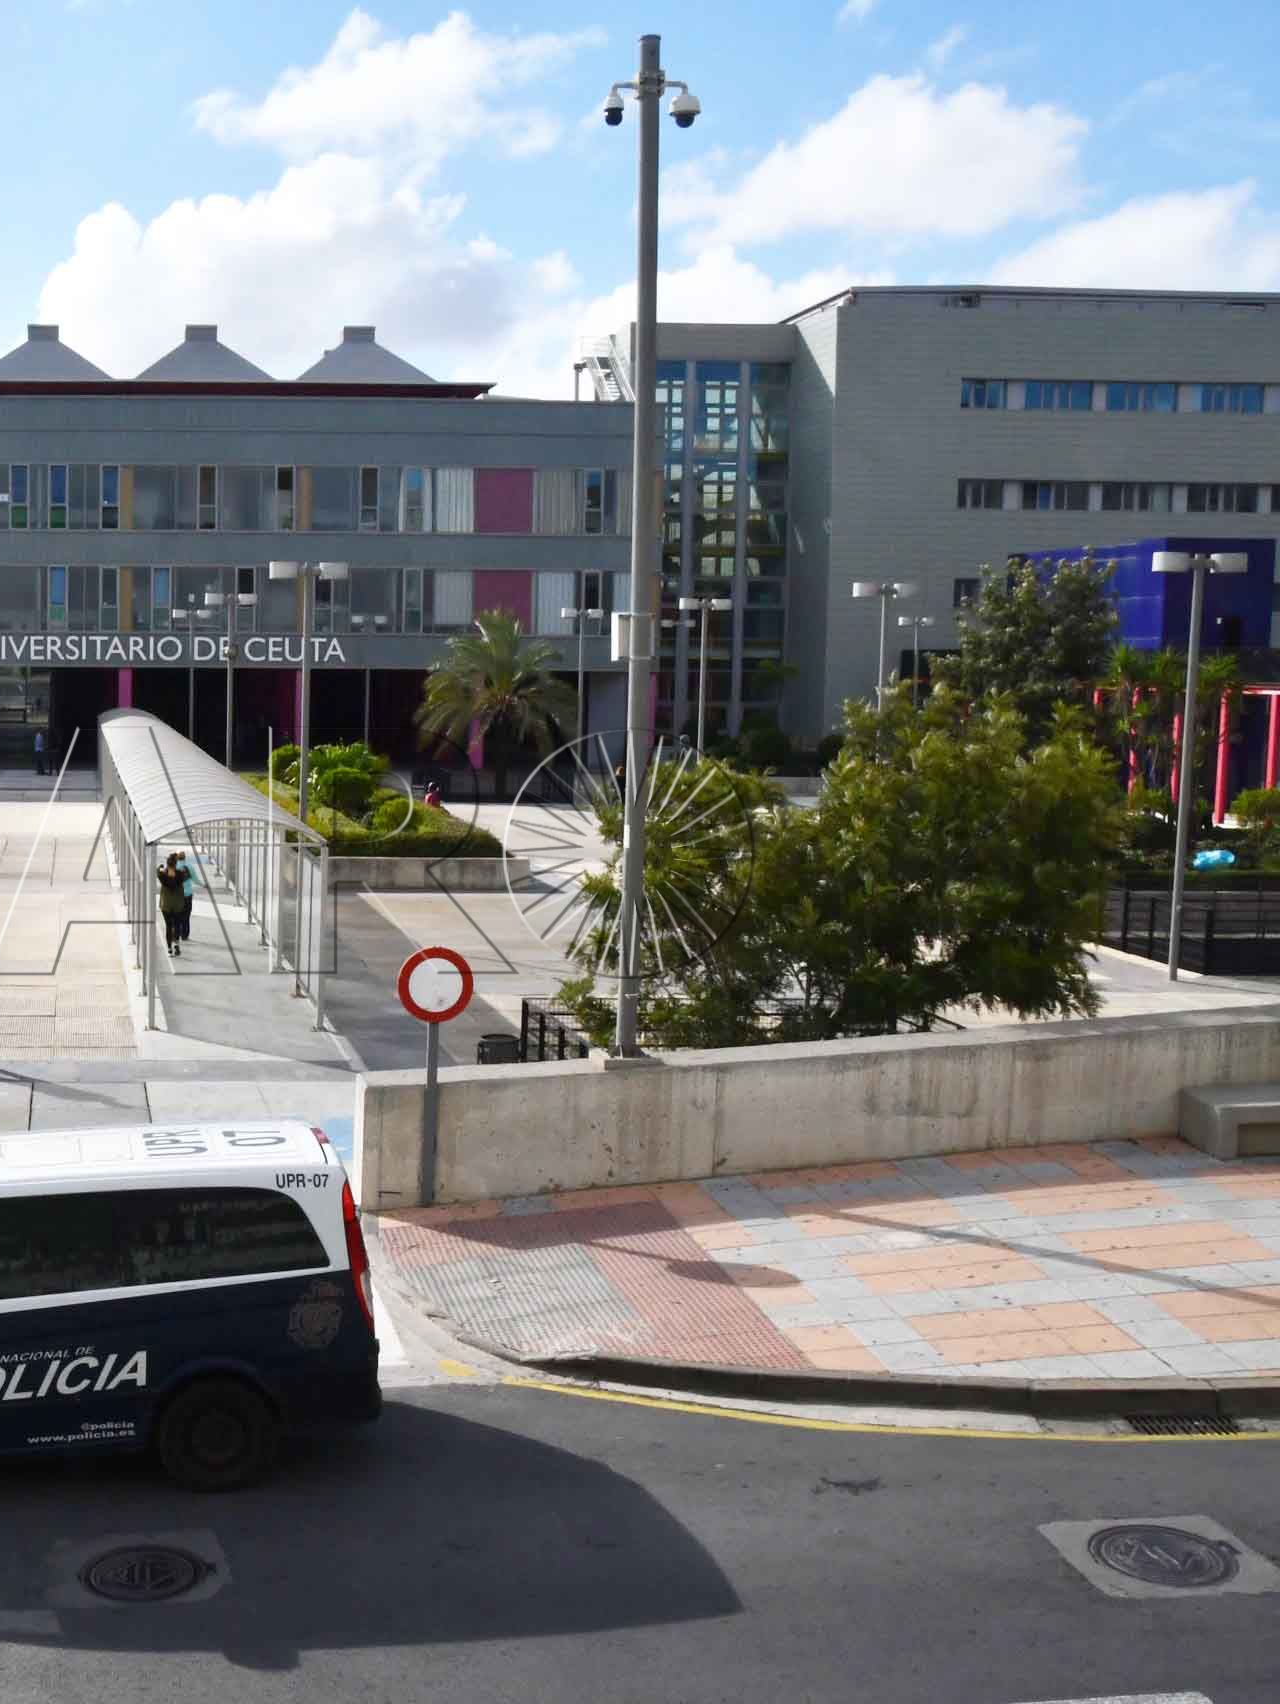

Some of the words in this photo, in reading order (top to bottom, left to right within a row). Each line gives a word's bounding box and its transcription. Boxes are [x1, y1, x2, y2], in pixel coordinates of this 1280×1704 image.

[193, 636, 231, 662] DE
[243, 636, 346, 663] CEUTA
[275, 1173, 329, 1189] UPR-07
[0, 1349, 70, 1364] NACIONAL
[74, 1345, 97, 1356] DE
[80, 1420, 136, 1432] @policia
[27, 1429, 137, 1445] www.policia.es
